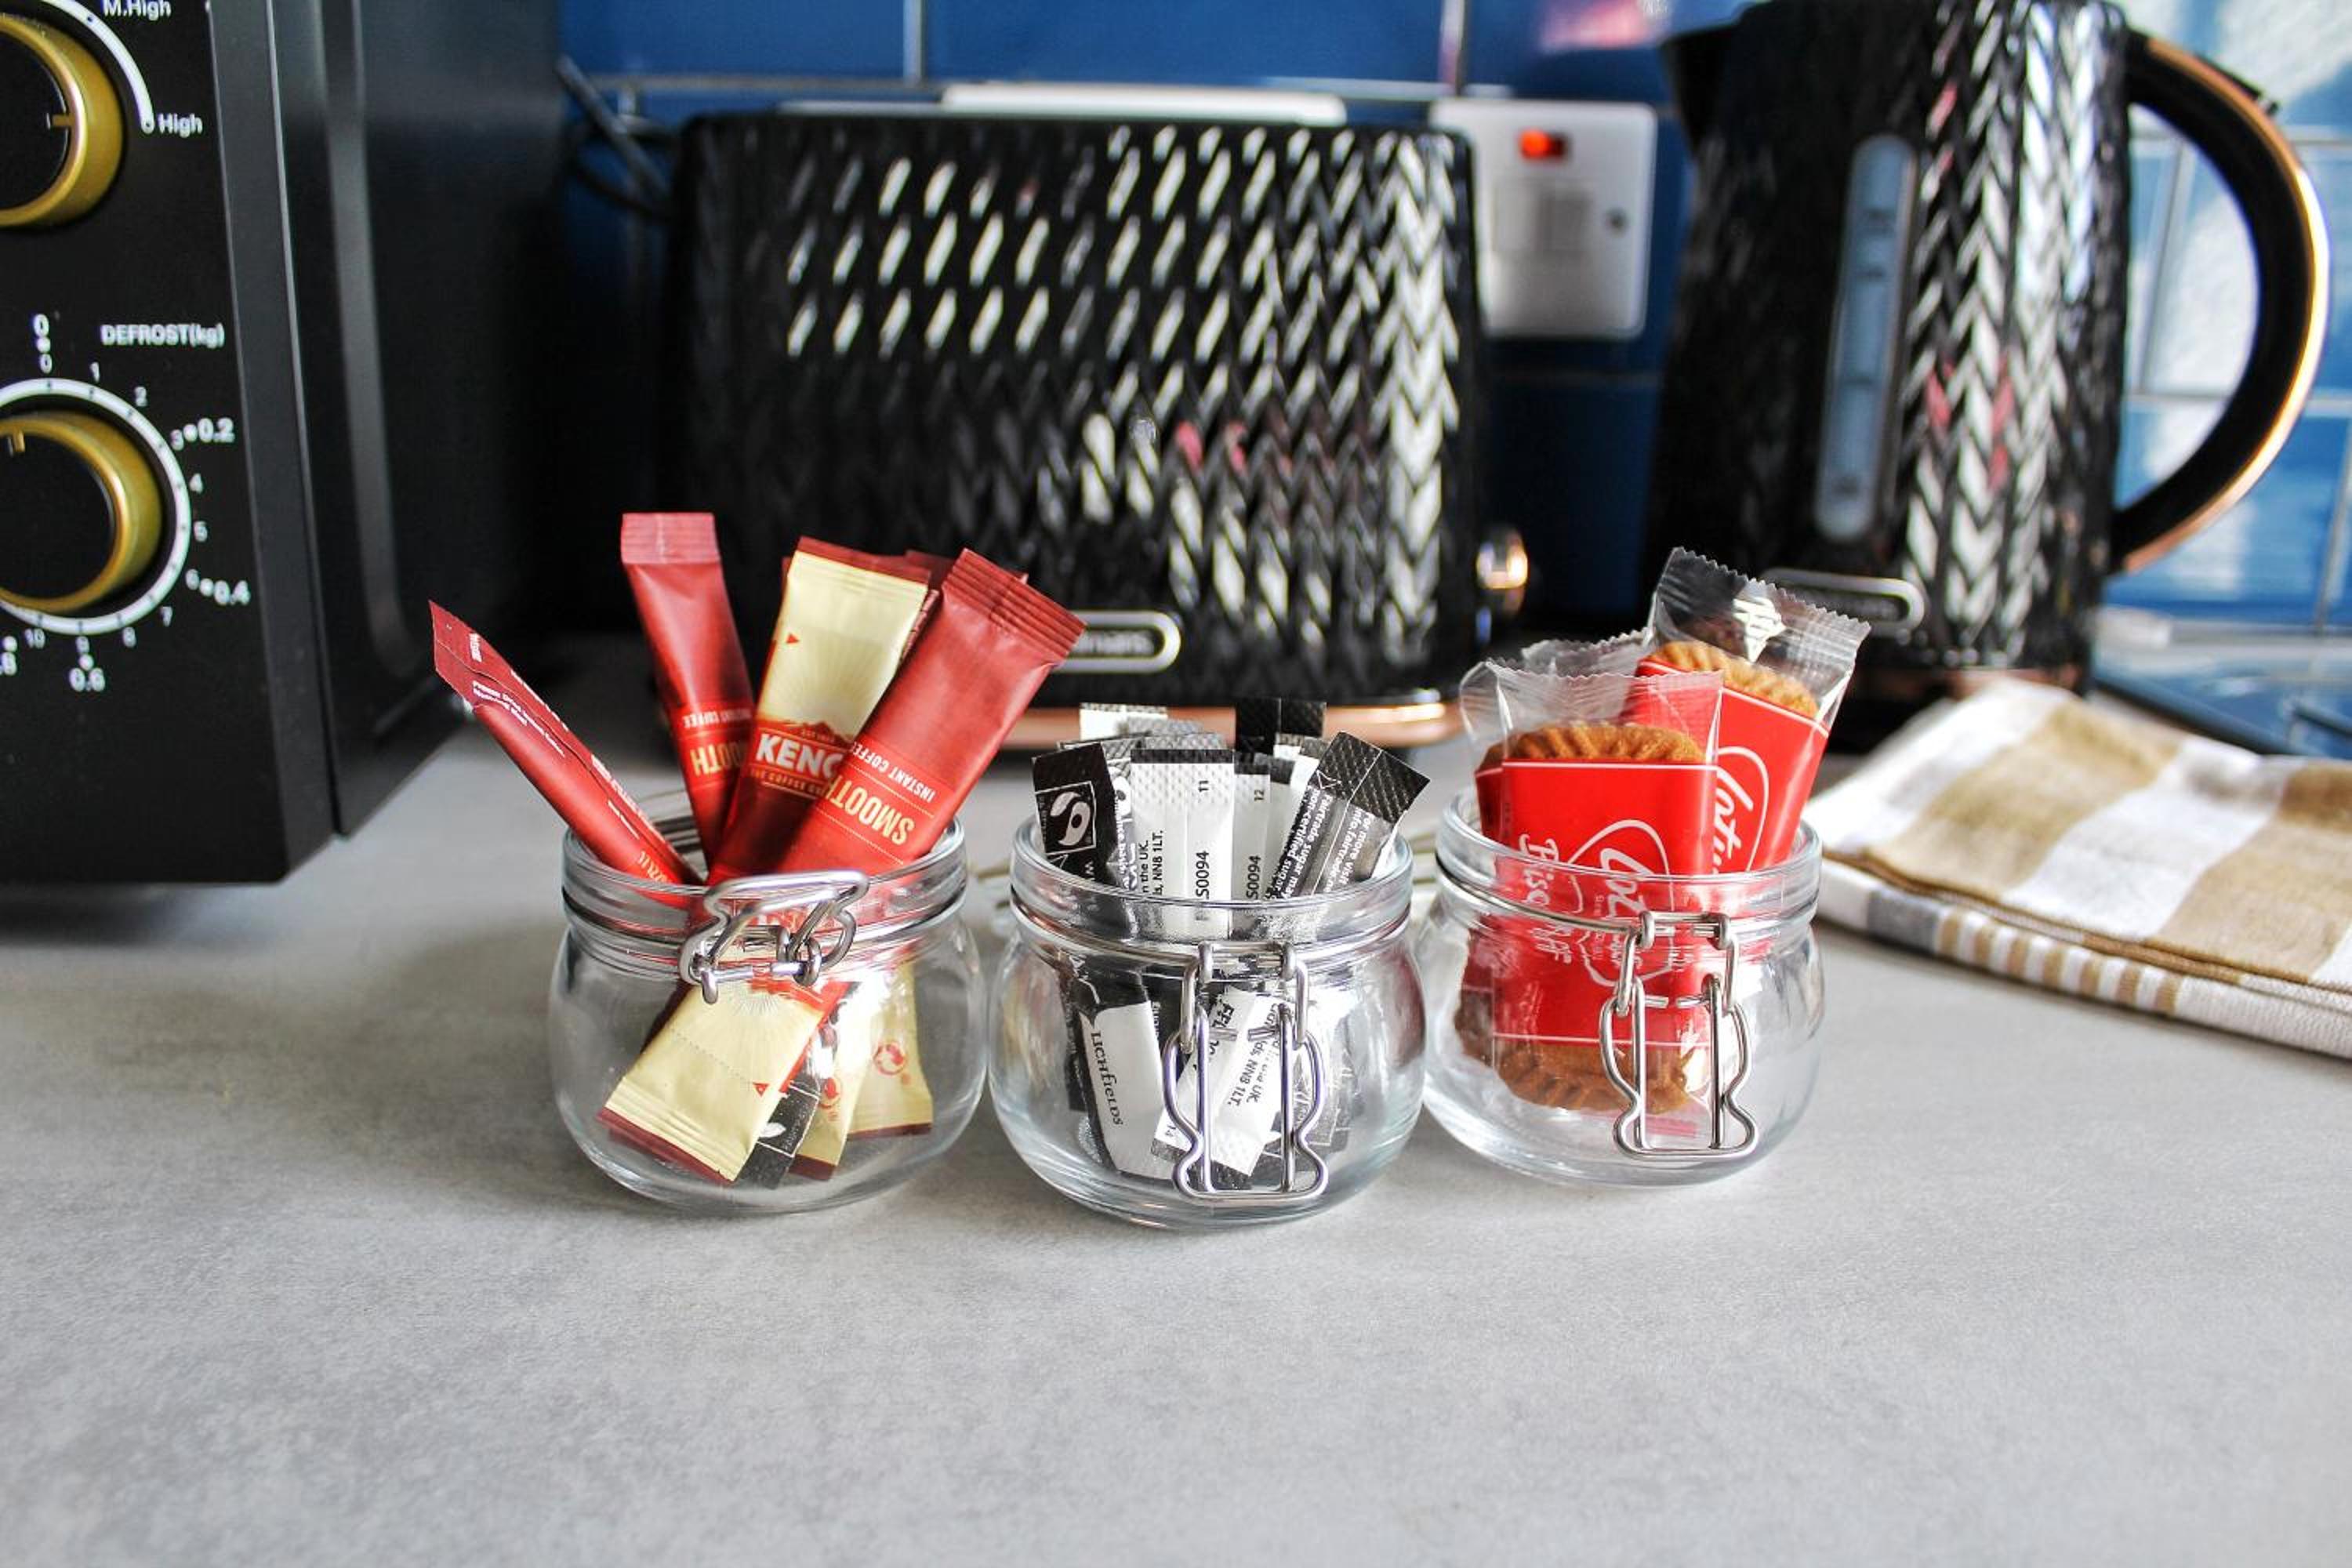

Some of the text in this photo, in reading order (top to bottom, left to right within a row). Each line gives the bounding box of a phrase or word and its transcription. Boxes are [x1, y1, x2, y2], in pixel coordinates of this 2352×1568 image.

[158, 114, 204, 138] High
[89, 361, 100, 383] 1
[135, 387, 148, 407] 2
[189, 473, 204, 493] 4
[162, 606, 173, 627] 7
[756, 733, 844, 779] KENC
[887, 767, 936, 804] INSTANT
[1198, 780, 1210, 793] 11
[1254, 789, 1265, 802] 12
[1287, 789, 1321, 861] non-certified
[1281, 794, 1334, 899] Fairtrade sugar may
[1350, 831, 1367, 860] more
[1139, 865, 1149, 883] the
[1152, 856, 1163, 881] NN8
[1196, 851, 1210, 899] S0094
